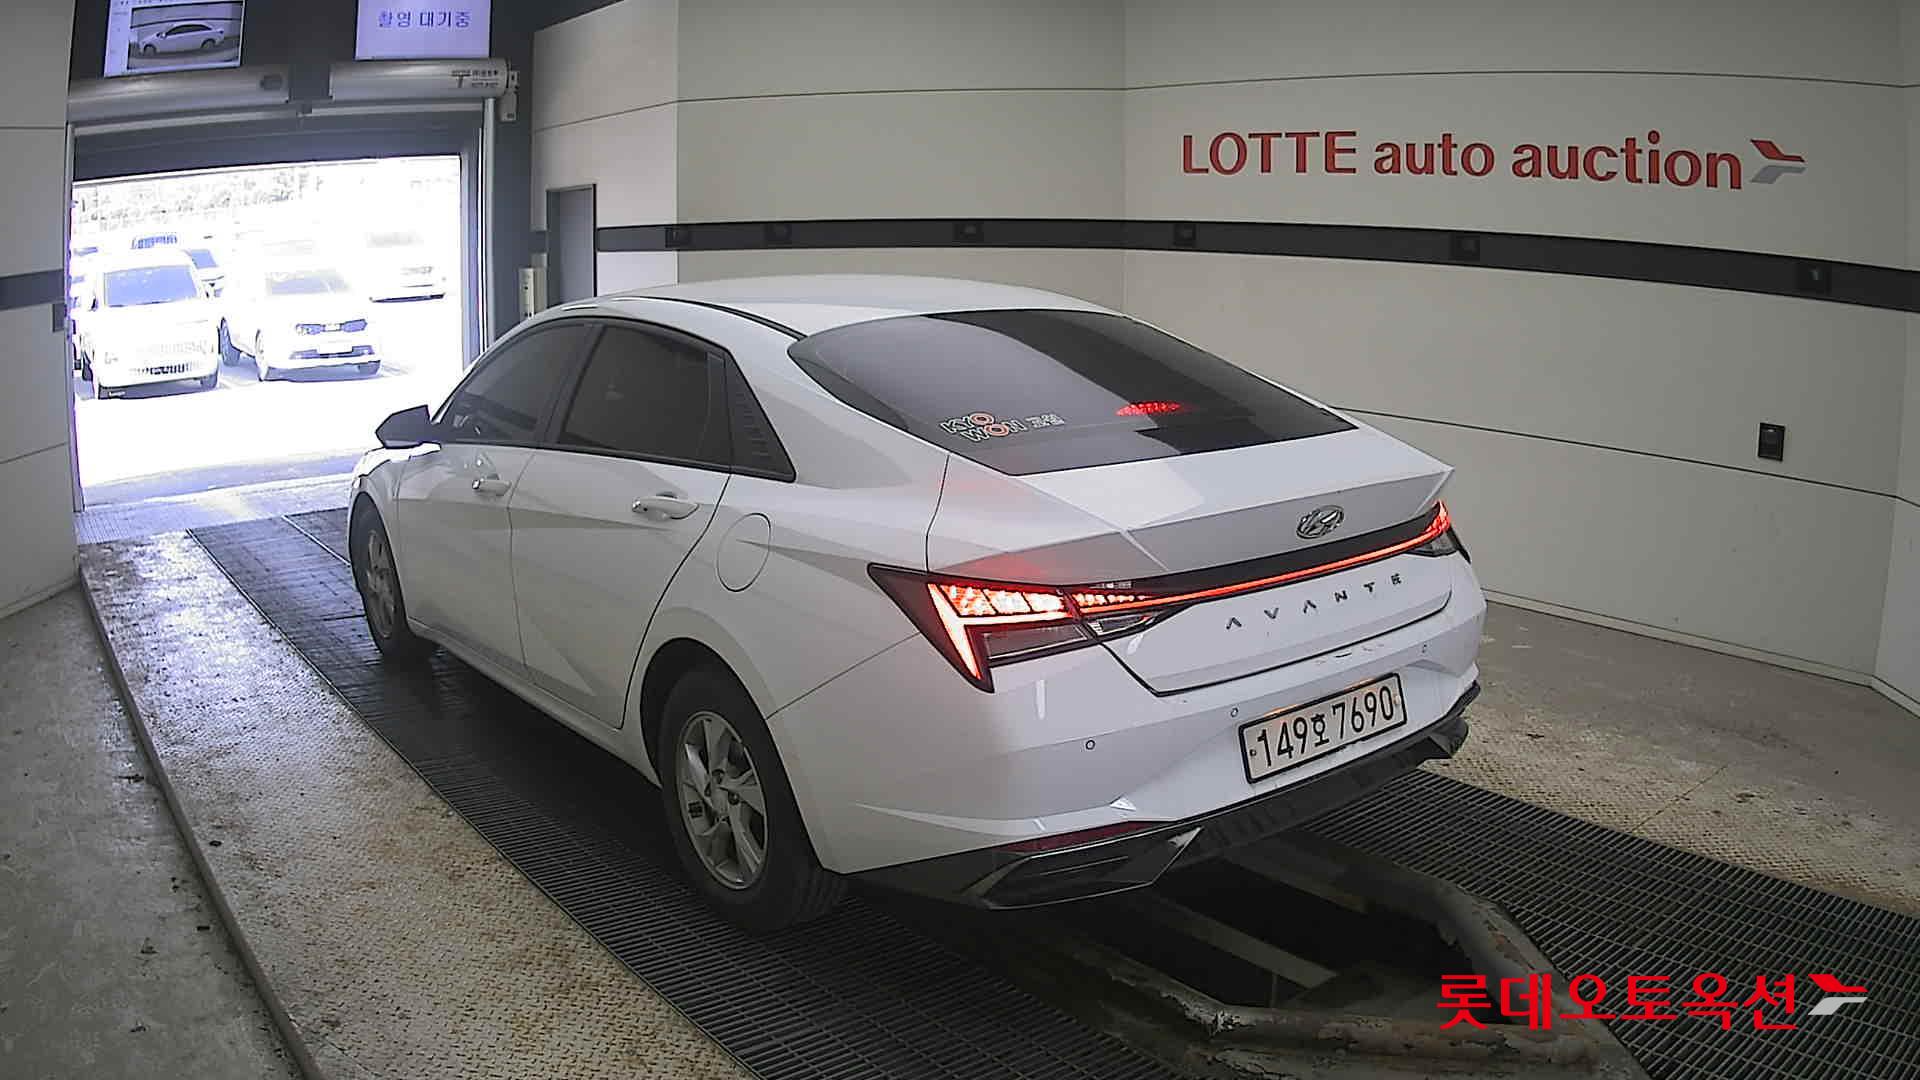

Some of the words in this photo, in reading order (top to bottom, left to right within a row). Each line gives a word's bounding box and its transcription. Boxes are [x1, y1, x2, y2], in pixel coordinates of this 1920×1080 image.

[420, 11, 471, 28] 대기중
[1183, 131, 1357, 175] LOTTE
[1374, 132, 1496, 178] auto
[1511, 130, 1743, 190] auction
[940, 411, 996, 434] KYO
[1226, 573, 1402, 630] AVANTE
